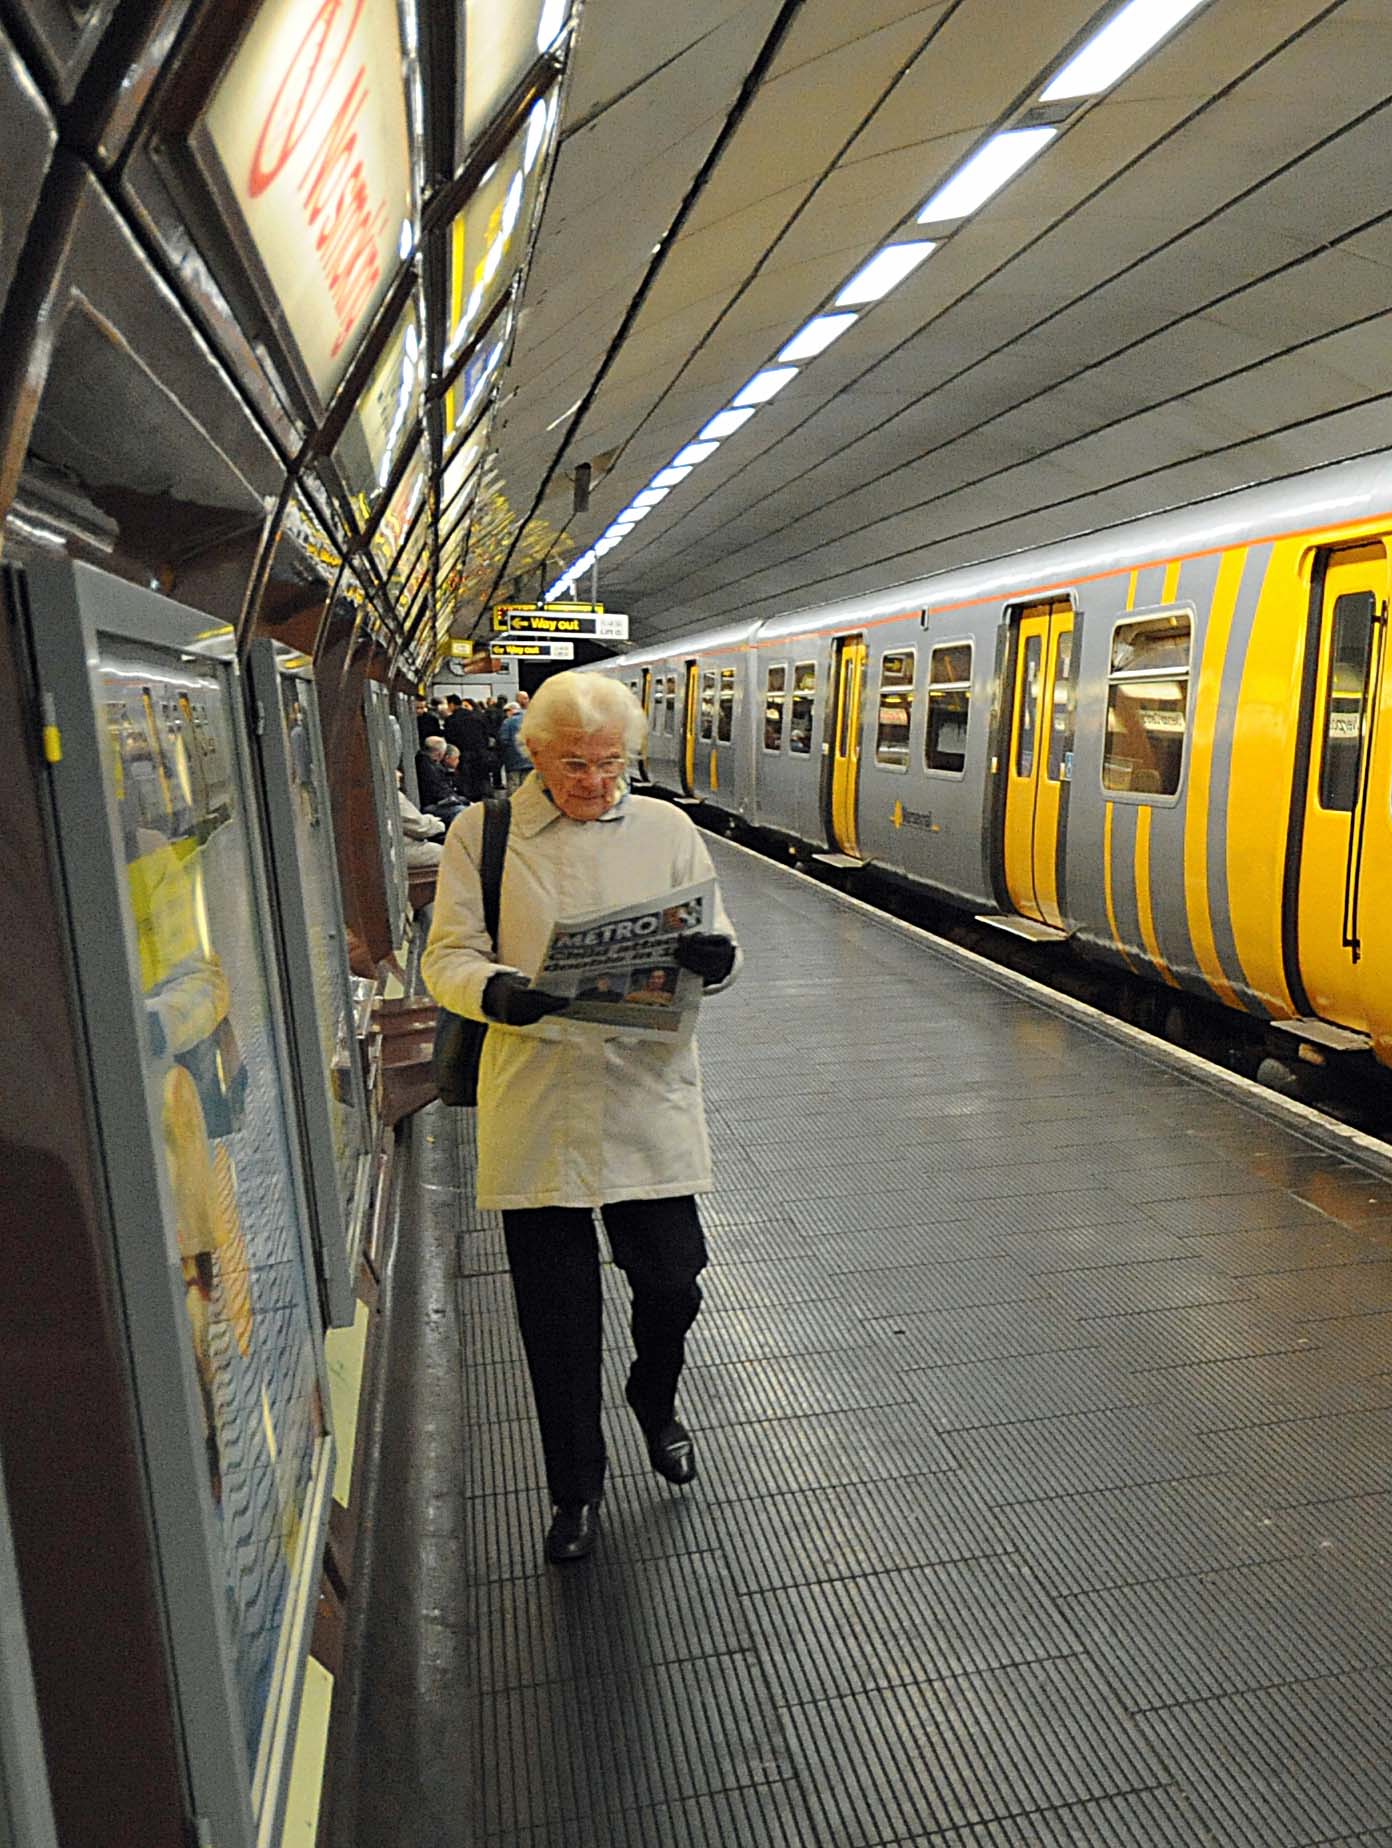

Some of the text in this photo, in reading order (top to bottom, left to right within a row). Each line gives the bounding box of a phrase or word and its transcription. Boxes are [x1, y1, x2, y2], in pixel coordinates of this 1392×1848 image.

[298, 61, 389, 358] No smoking
[530, 617, 580, 631] Way out
[506, 645, 540, 655] Way out
[556, 916, 659, 944] METRO
